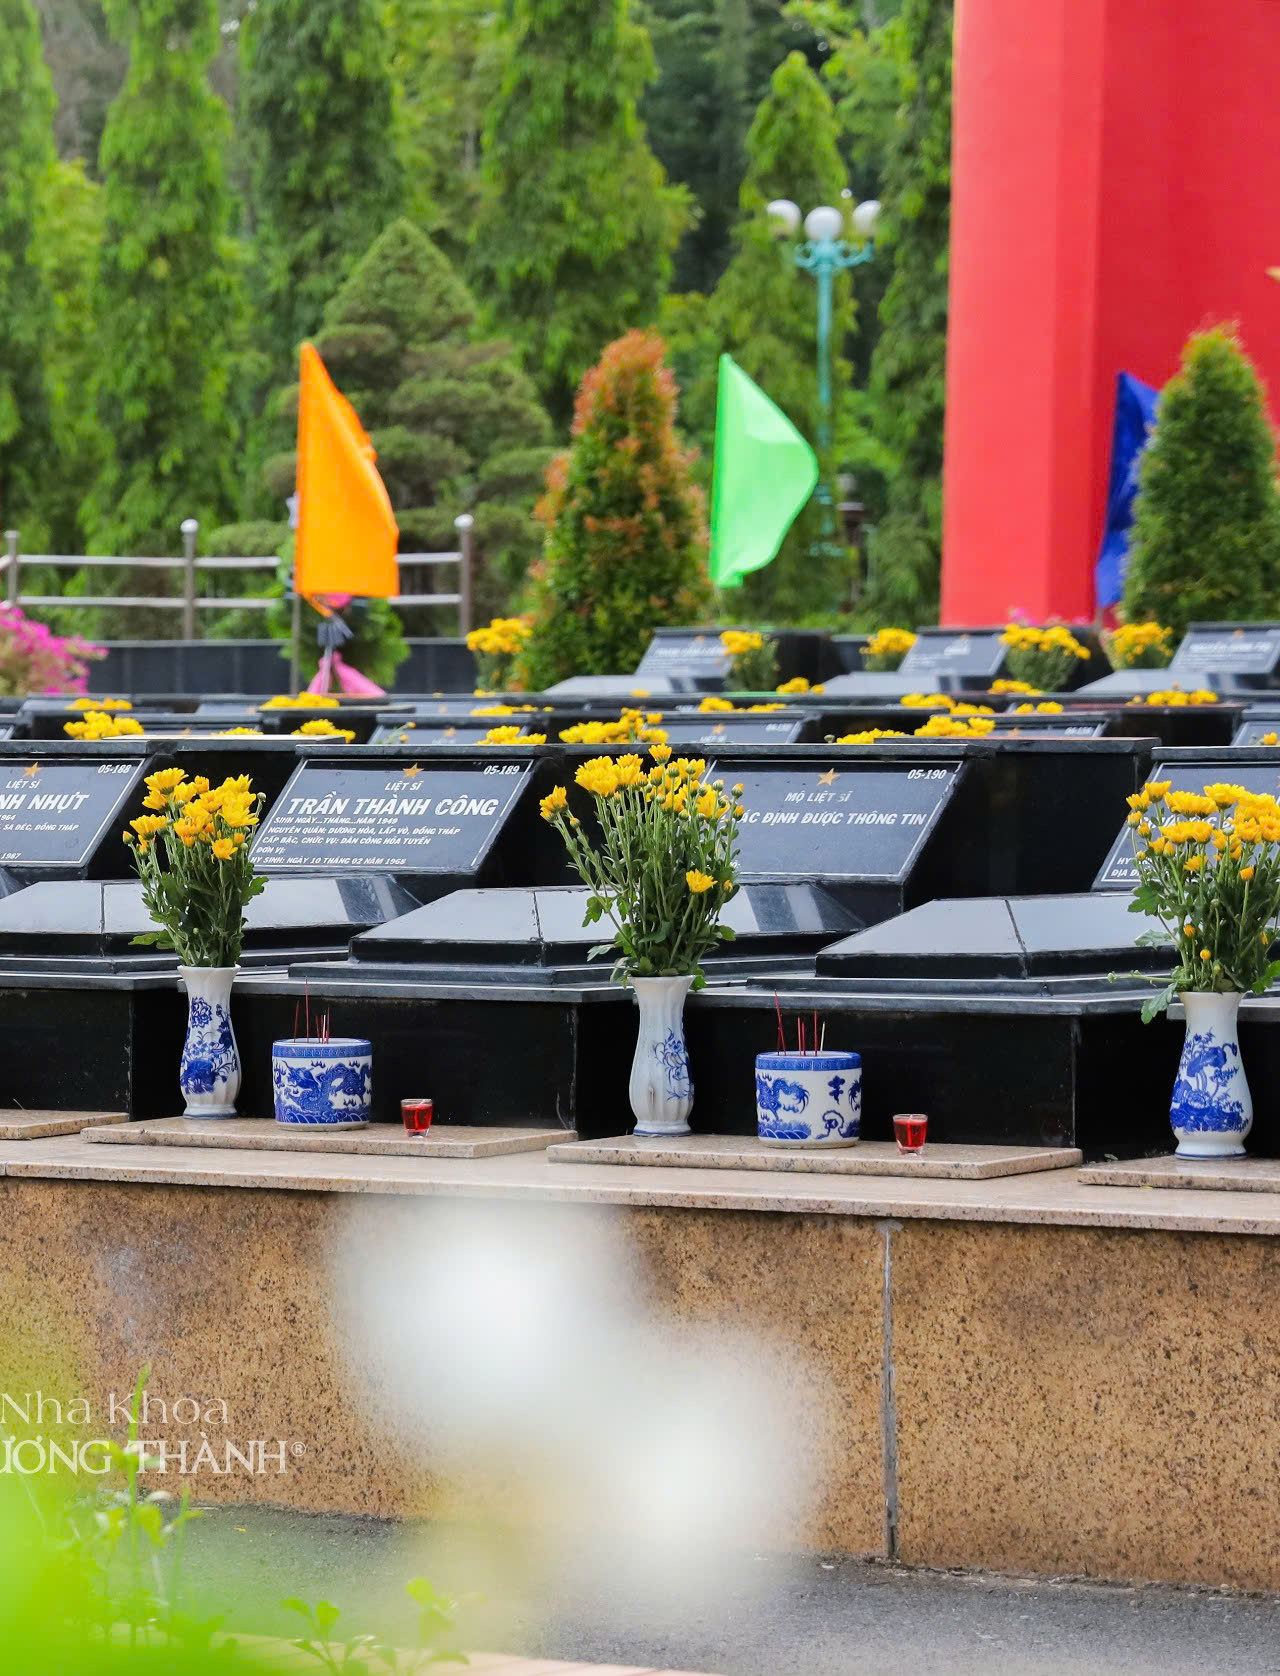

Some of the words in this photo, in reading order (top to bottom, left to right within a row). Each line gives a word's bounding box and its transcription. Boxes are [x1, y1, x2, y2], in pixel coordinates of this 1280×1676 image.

[98, 764, 132, 774] 05-188
[483, 765, 520, 775] 05-189
[907, 769, 947, 780] 05-190
[6, 778, 29, 790] LIỆT
[384, 781, 410, 792] LIỆT
[27, 792, 90, 813] NHỰT
[784, 790, 805, 804] MỘ
[807, 791, 836, 803] LIỆT
[287, 791, 350, 815] TRẦN
[353, 793, 432, 816] THÀNH
[435, 794, 499, 816] CÔNG
[734, 809, 760, 824] ÁC
[761, 812, 800, 826] ĐỊNH
[801, 811, 843, 826] ĐƯỢC
[846, 810, 898, 825] THÔNG
[900, 813, 927, 825] TIN
[378, 826, 396, 834] LẤP
[437, 827, 461, 835] THÁP
[301, 836, 324, 844] CHỨC
[363, 857, 384, 865] NĂM
[1117, 857, 1132, 865] HY
